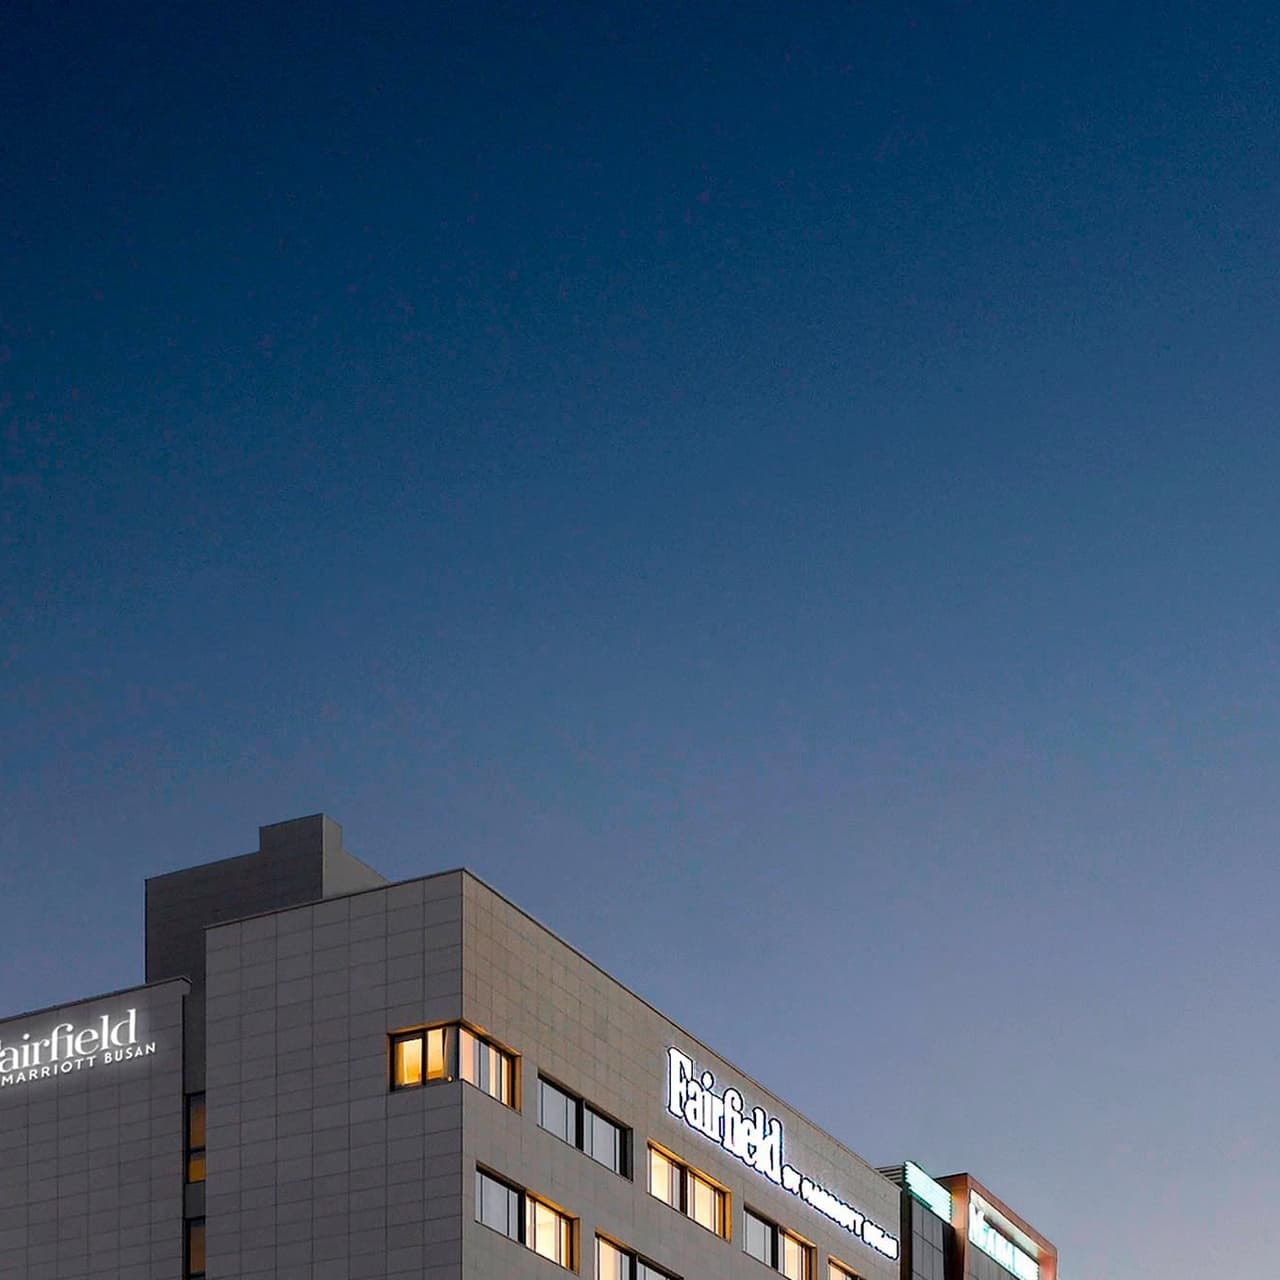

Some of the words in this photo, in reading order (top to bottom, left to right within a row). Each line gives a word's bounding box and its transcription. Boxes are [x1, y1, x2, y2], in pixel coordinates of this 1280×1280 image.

[1, 1055, 97, 1087] MARRIOTT
[104, 1042, 156, 1064] BUSAN
[668, 1047, 783, 1185] Fairfield
